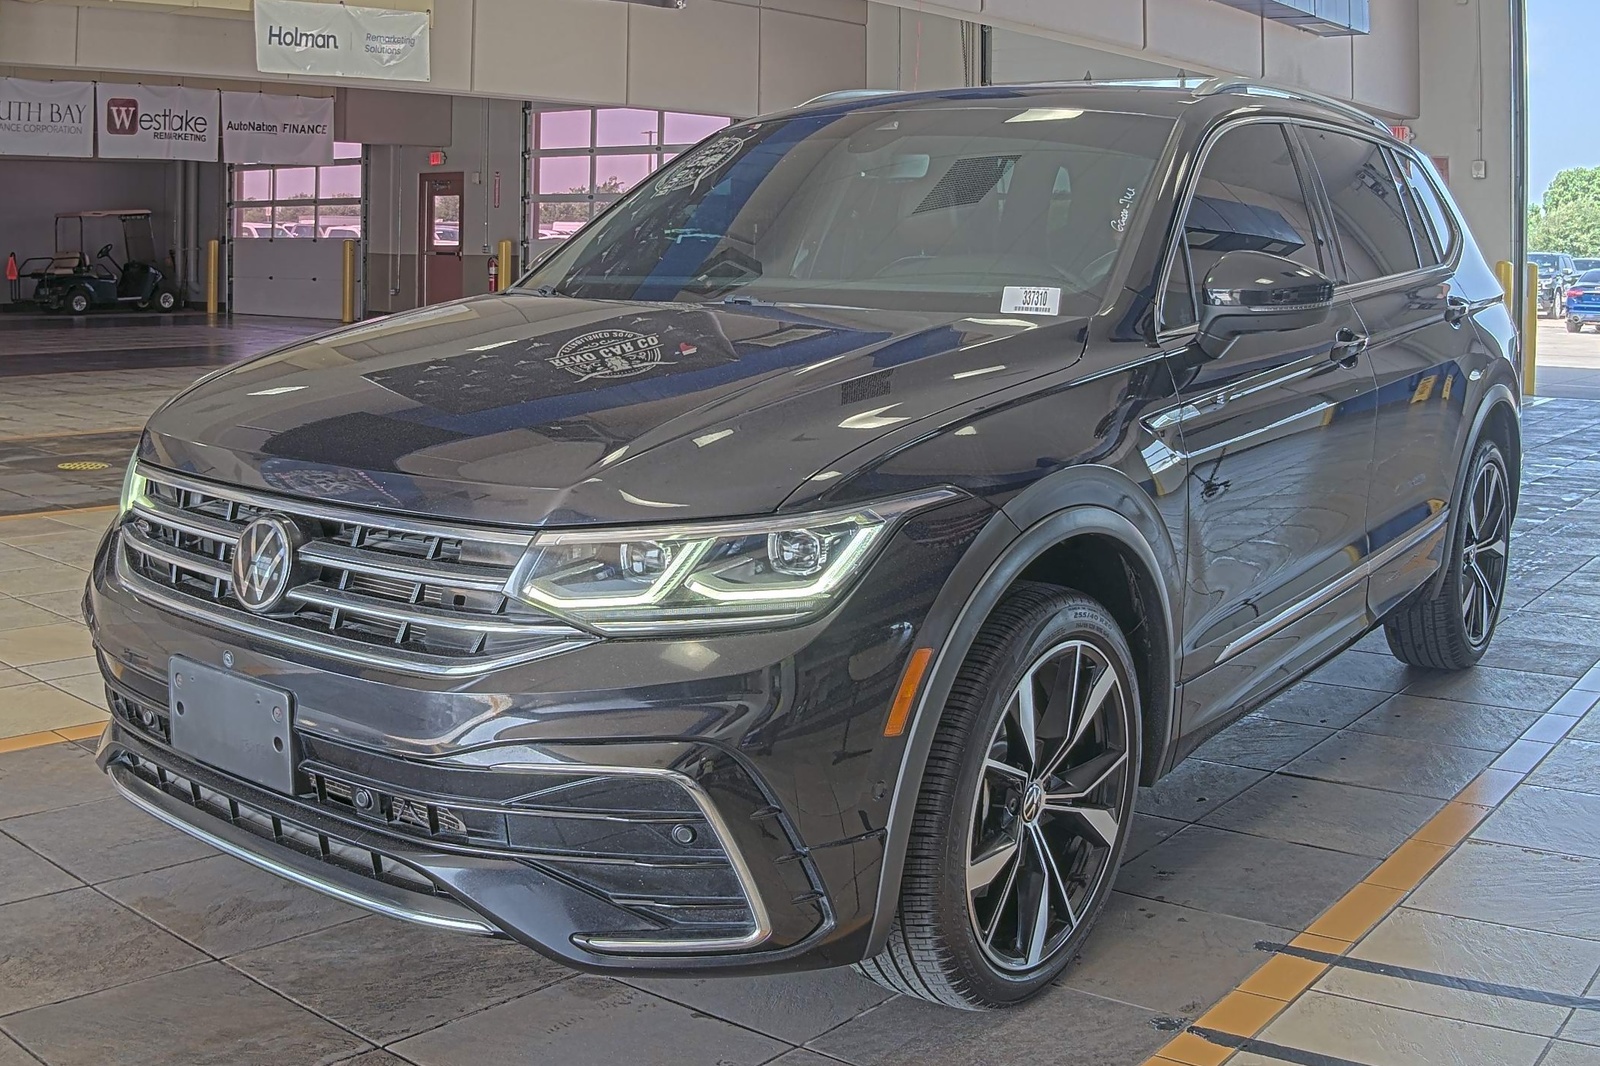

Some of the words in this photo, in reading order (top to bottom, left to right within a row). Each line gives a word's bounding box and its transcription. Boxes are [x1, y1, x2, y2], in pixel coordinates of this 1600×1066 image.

[268, 25, 339, 49] Holman
[365, 32, 416, 48] Remarketing
[364, 44, 401, 55] Solutions
[50, 103, 87, 124] BAY
[110, 106, 208, 133] Westlake
[23, 124, 83, 135] CORPORATION
[226, 120, 278, 133] AutoNation
[282, 123, 327, 135] FINANCE
[153, 132, 207, 142] REMARKETING
[1022, 290, 1048, 306] 337310
